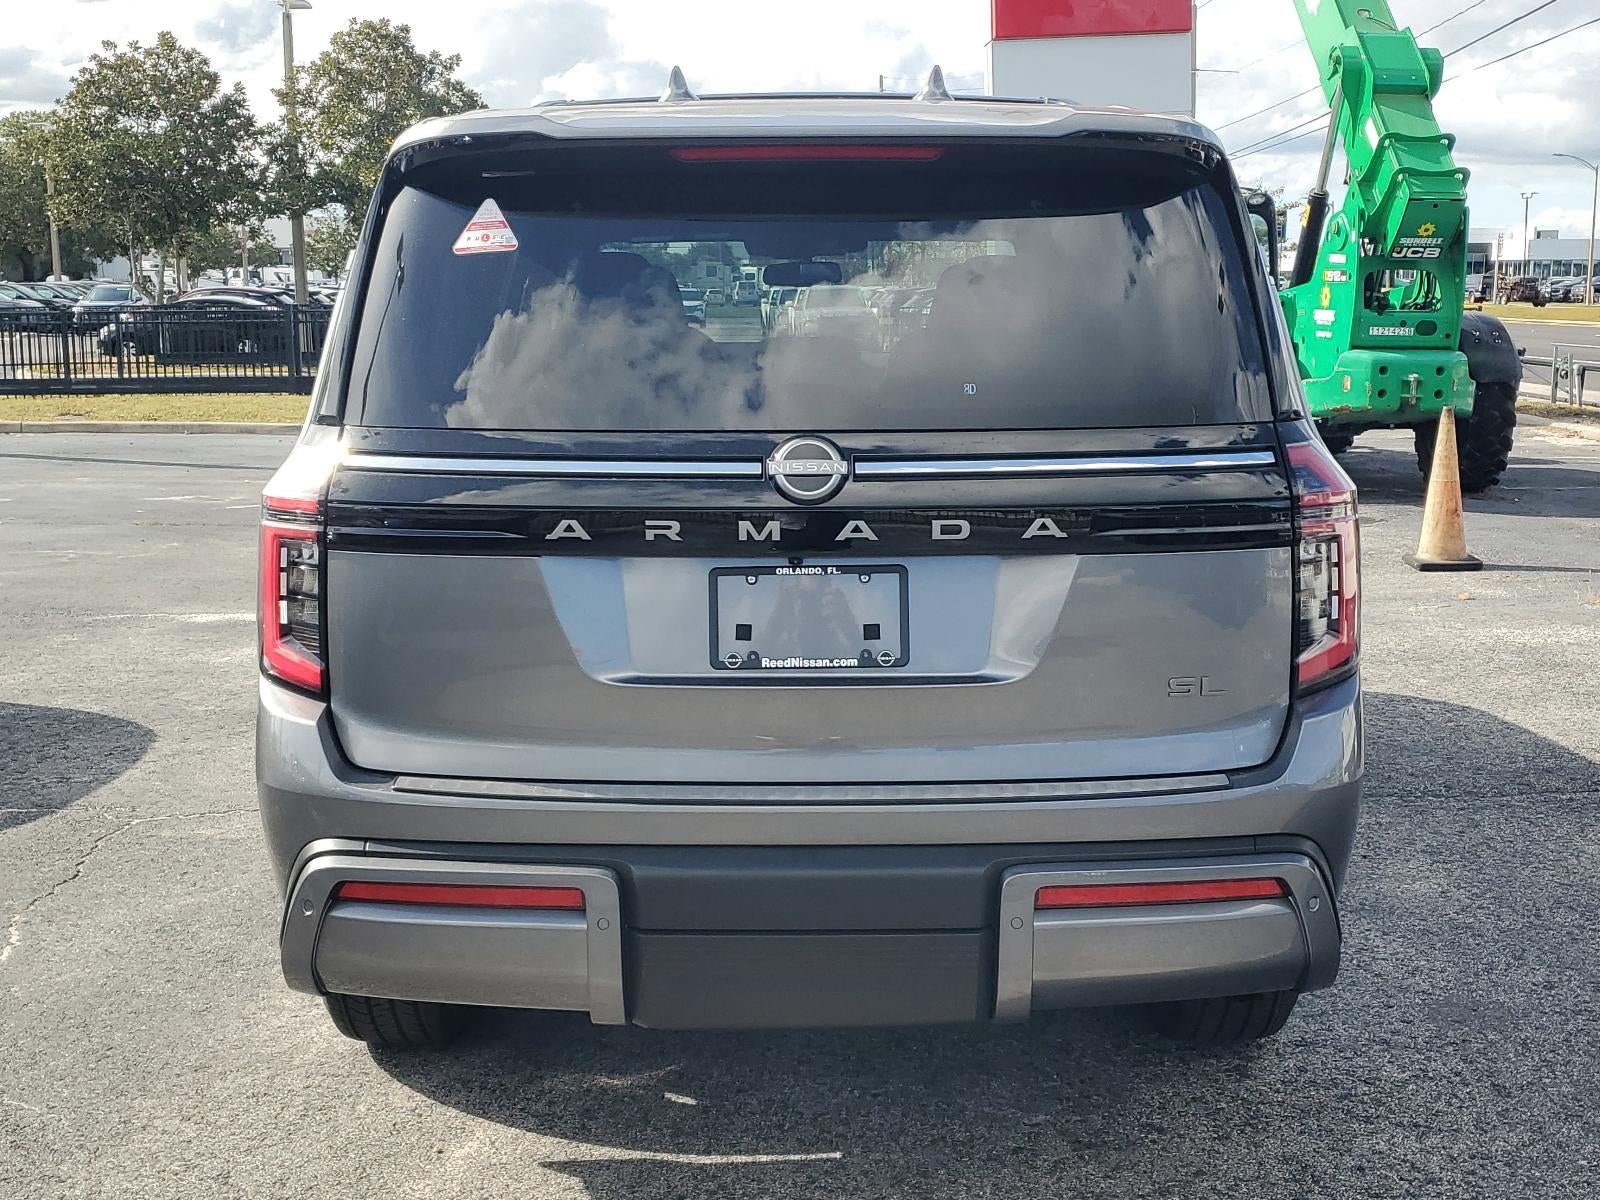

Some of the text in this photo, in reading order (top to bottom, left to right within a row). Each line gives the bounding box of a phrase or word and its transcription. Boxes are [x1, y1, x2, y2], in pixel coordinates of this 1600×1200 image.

[1392, 247, 1441, 258] JCB
[771, 462, 845, 472] NISSAN
[544, 517, 1069, 542] ARMADA
[775, 567, 842, 576] ORLANDO, FL.
[761, 657, 858, 668] ReedNissan.com
[1168, 675, 1227, 697] SL
